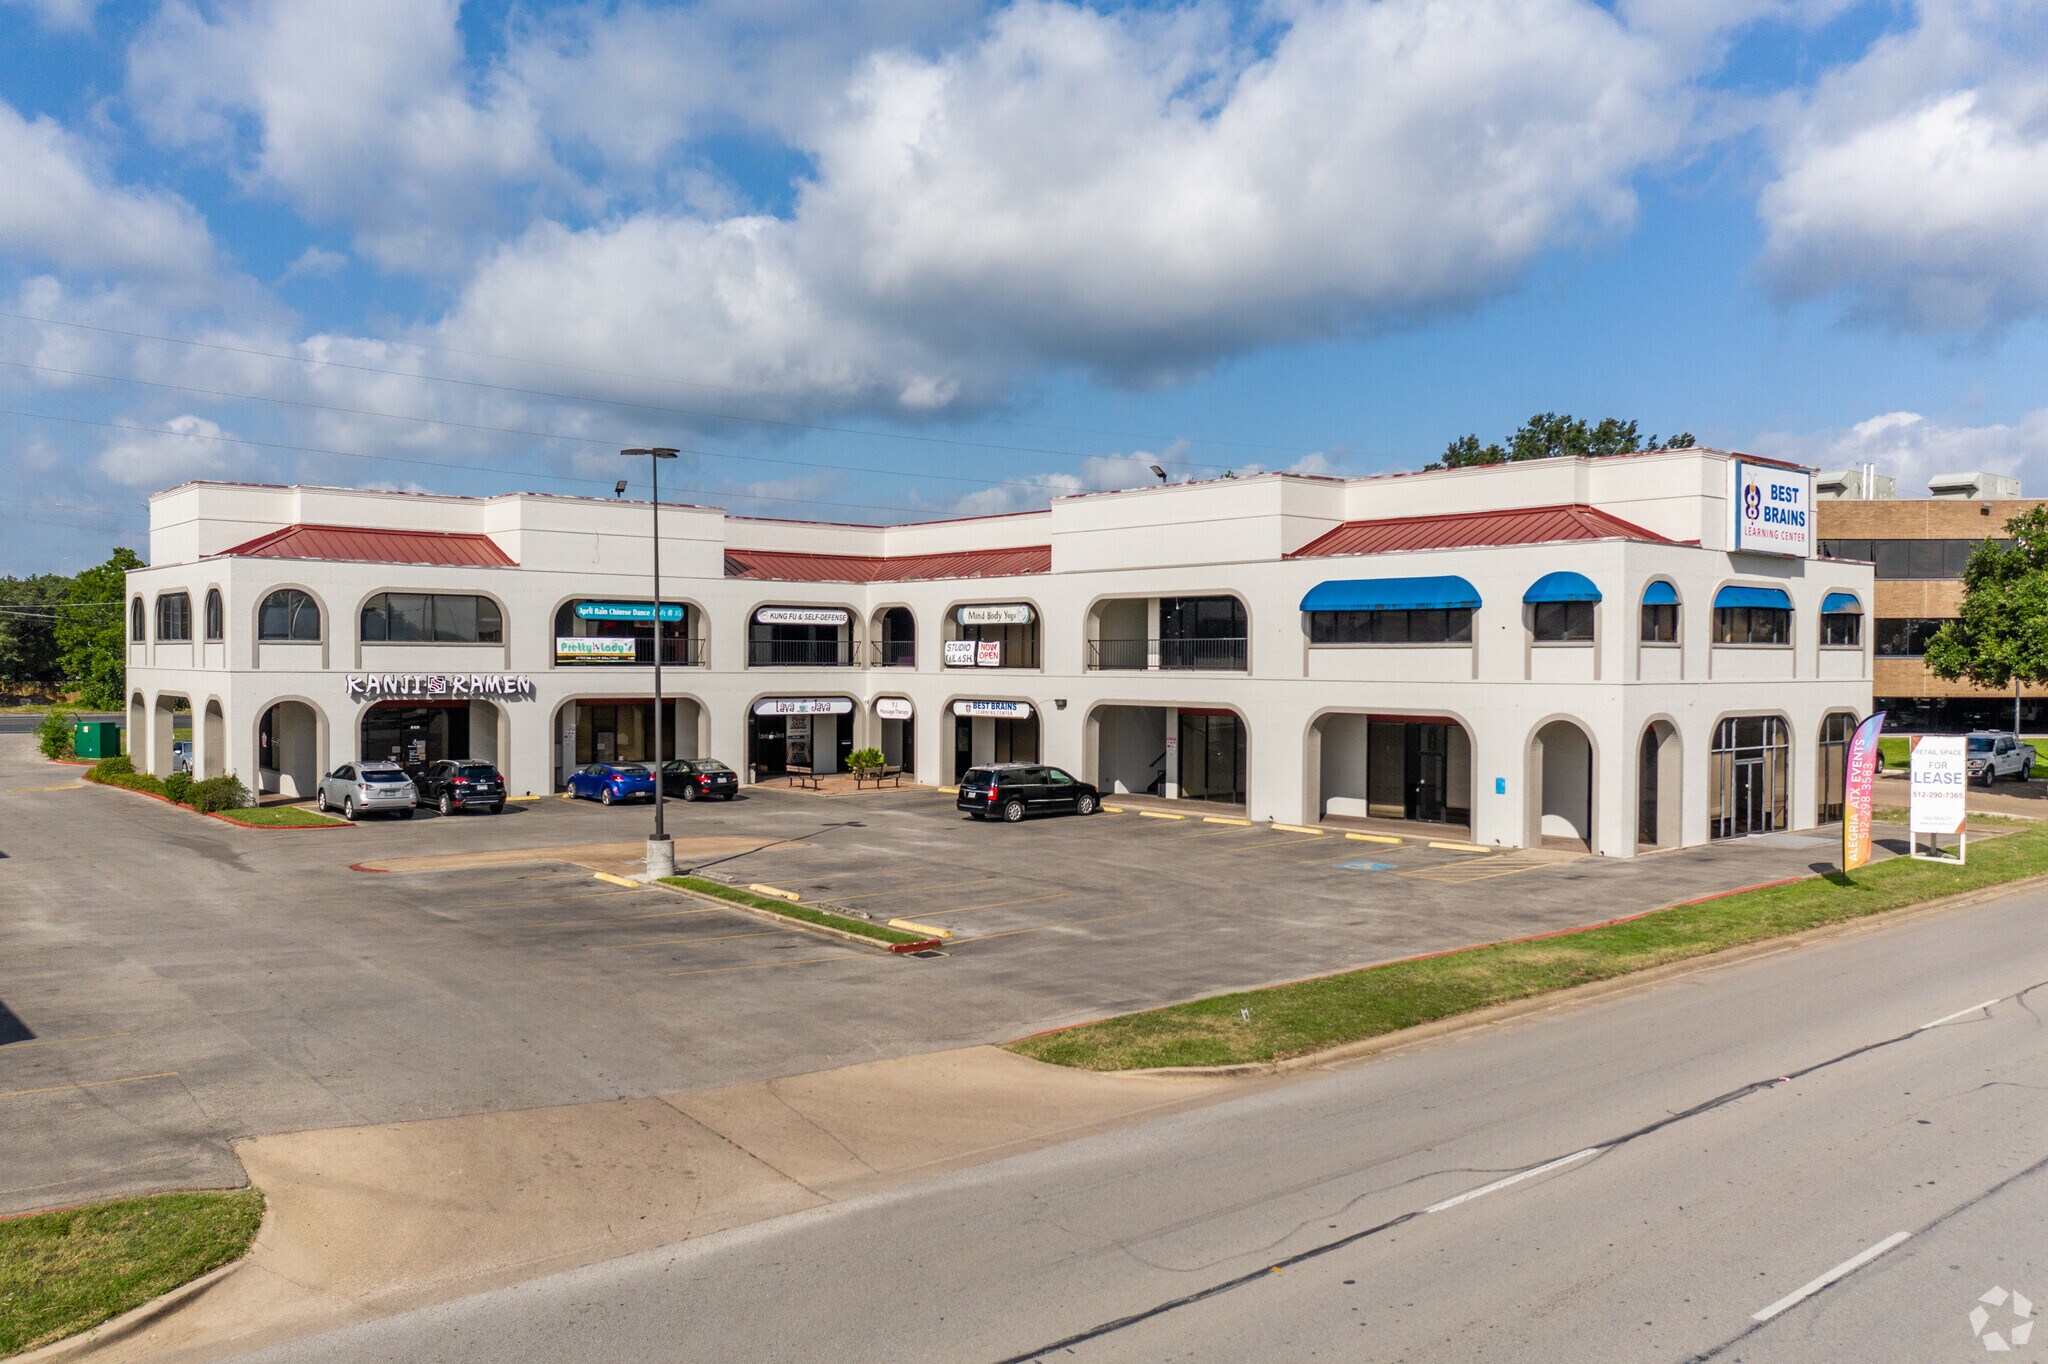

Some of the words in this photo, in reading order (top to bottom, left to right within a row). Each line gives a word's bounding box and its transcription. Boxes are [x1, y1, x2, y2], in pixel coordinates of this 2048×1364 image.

[1771, 484, 1799, 503] BEST
[1764, 506, 1805, 527] BRAINS
[1744, 527, 1778, 540] LEARNING
[1781, 531, 1805, 542] CENTER
[579, 606, 594, 616] April
[594, 606, 608, 615] Rain
[609, 608, 632, 616] Chinese
[770, 612, 788, 620] KUNG
[804, 614, 847, 622] SELF-DEFENSE
[968, 610, 985, 620] Mind
[986, 610, 1003, 622] Body
[1004, 610, 1017, 622] Yoga
[560, 642, 592, 654] Pretty
[946, 644, 972, 652] STUDIO
[979, 652, 999, 660] OPEN
[345, 674, 422, 695] KANJI
[451, 674, 531, 695] RAMEN
[776, 700, 795, 712] Lava
[810, 700, 832, 712] Java
[972, 702, 990, 710] BEST
[991, 702, 1018, 711] BRAINS
[1851, 739, 1866, 783] EVENTS
[1928, 761, 1948, 770] FOR
[1913, 772, 1963, 785] LEASE
[1850, 787, 1861, 810] ATX
[1859, 762, 1874, 840] 512-298-3583
[1912, 791, 1964, 799] 512-290-7365
[1848, 813, 1860, 862] ALEGRIA
